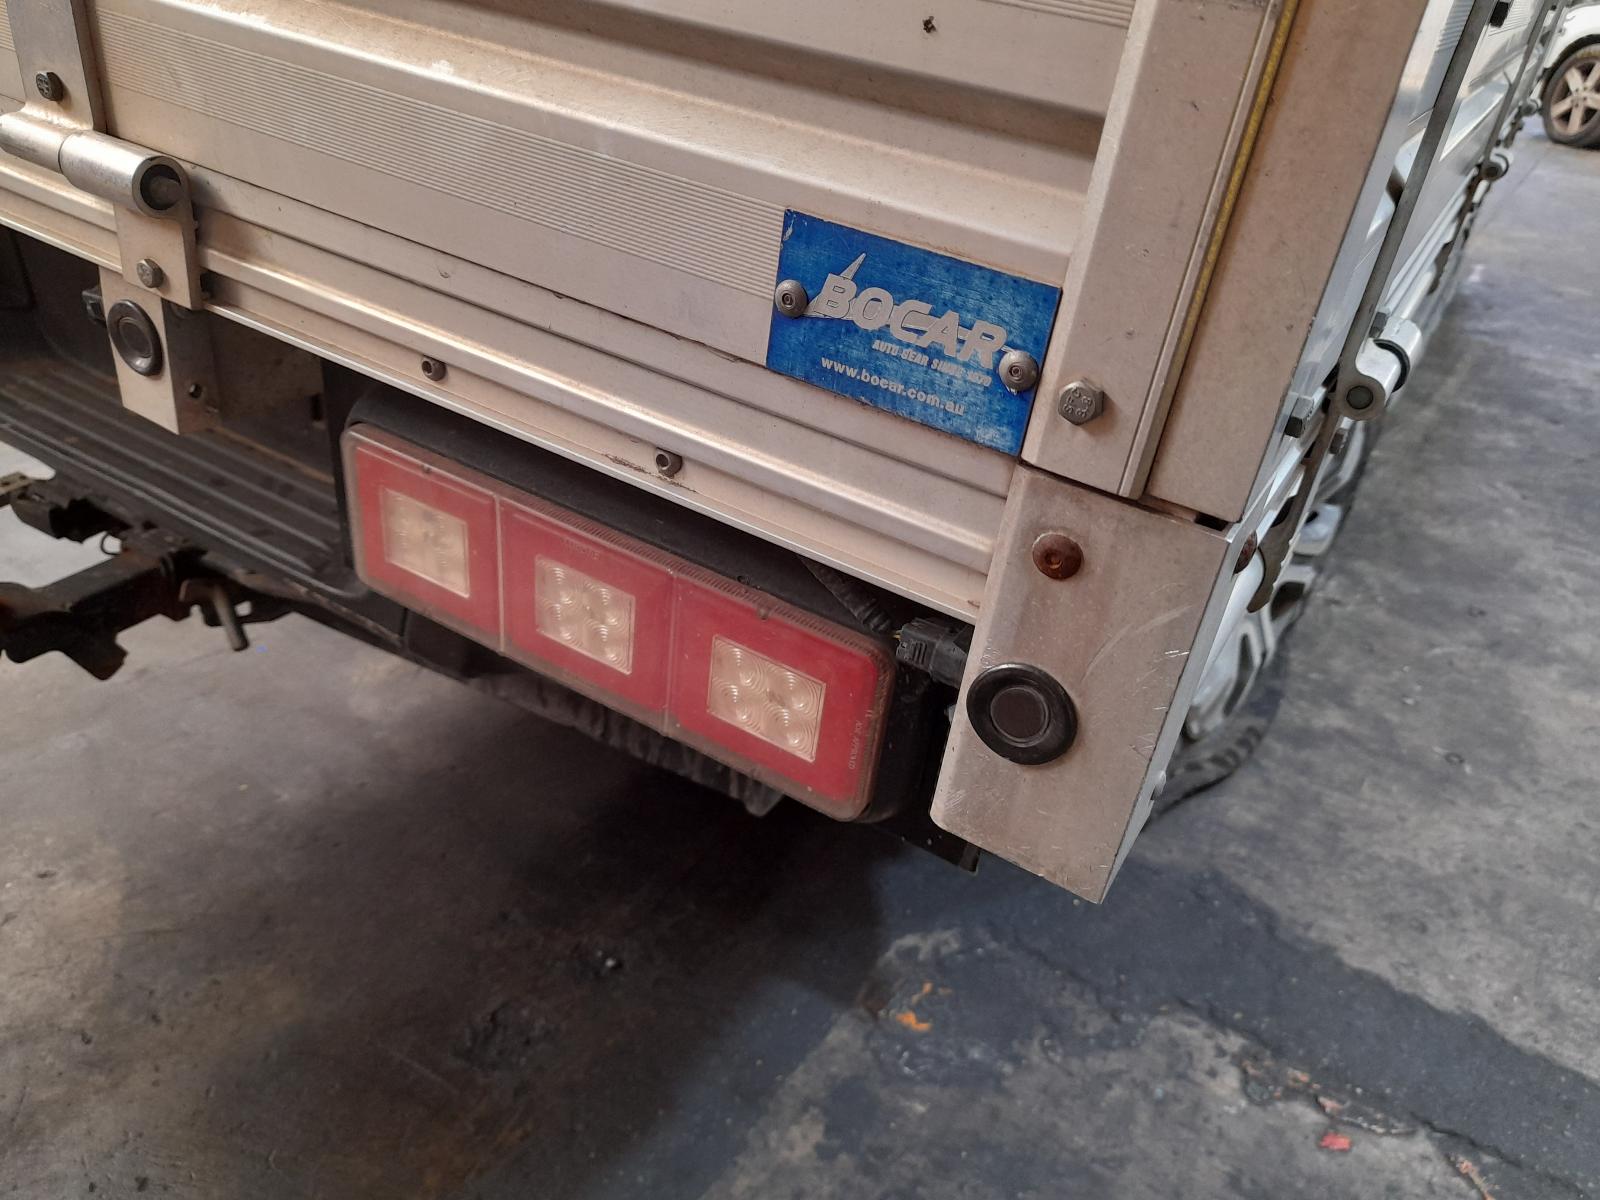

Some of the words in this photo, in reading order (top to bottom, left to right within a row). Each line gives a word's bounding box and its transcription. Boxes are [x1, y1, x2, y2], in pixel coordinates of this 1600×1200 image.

[812, 272, 1008, 370] BOCAR
[821, 357, 966, 416] www.bocar.com.au
[901, 347, 930, 367] GEAR
